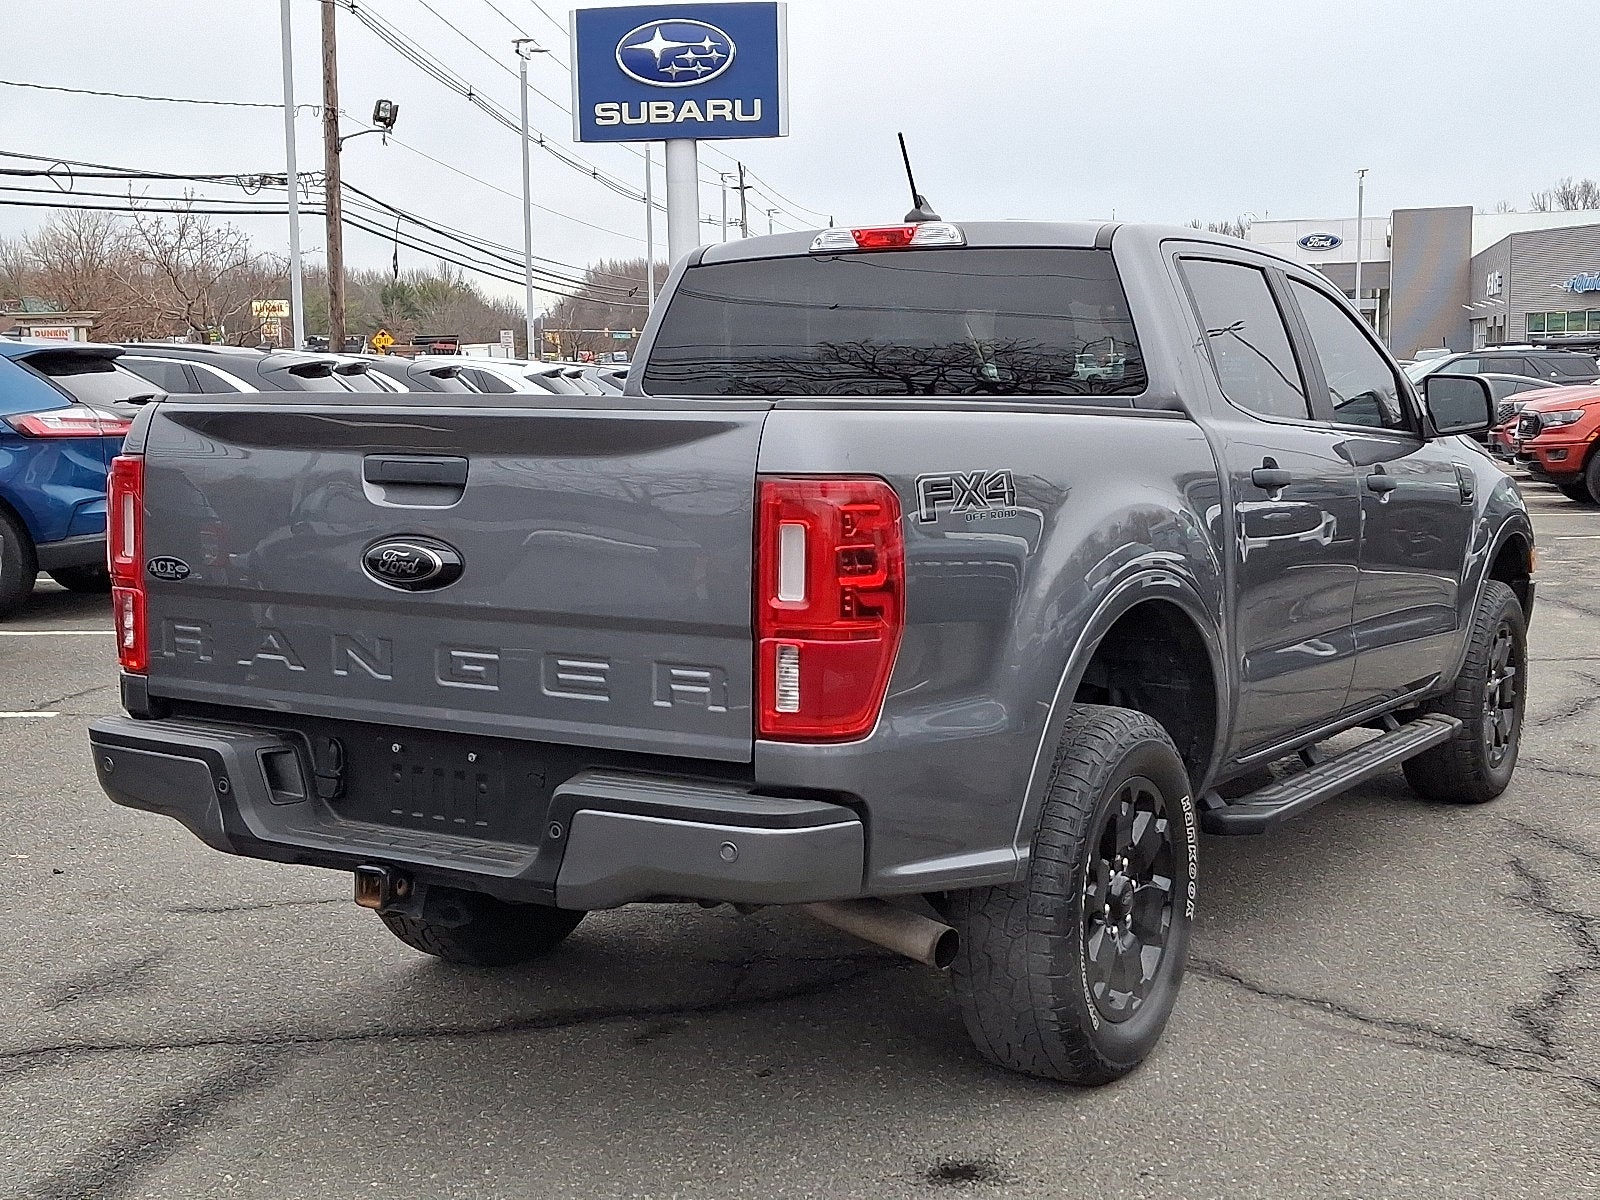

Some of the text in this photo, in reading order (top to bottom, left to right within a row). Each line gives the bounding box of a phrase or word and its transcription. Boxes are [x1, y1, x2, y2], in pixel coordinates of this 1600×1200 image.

[594, 98, 762, 125] SUBARU
[1306, 236, 1332, 247] Ford
[915, 469, 1016, 524] FX4
[965, 509, 1017, 522] OFF ROAD
[149, 560, 176, 573] ACE
[379, 549, 420, 573] Ford
[161, 617, 729, 713] RANGER
